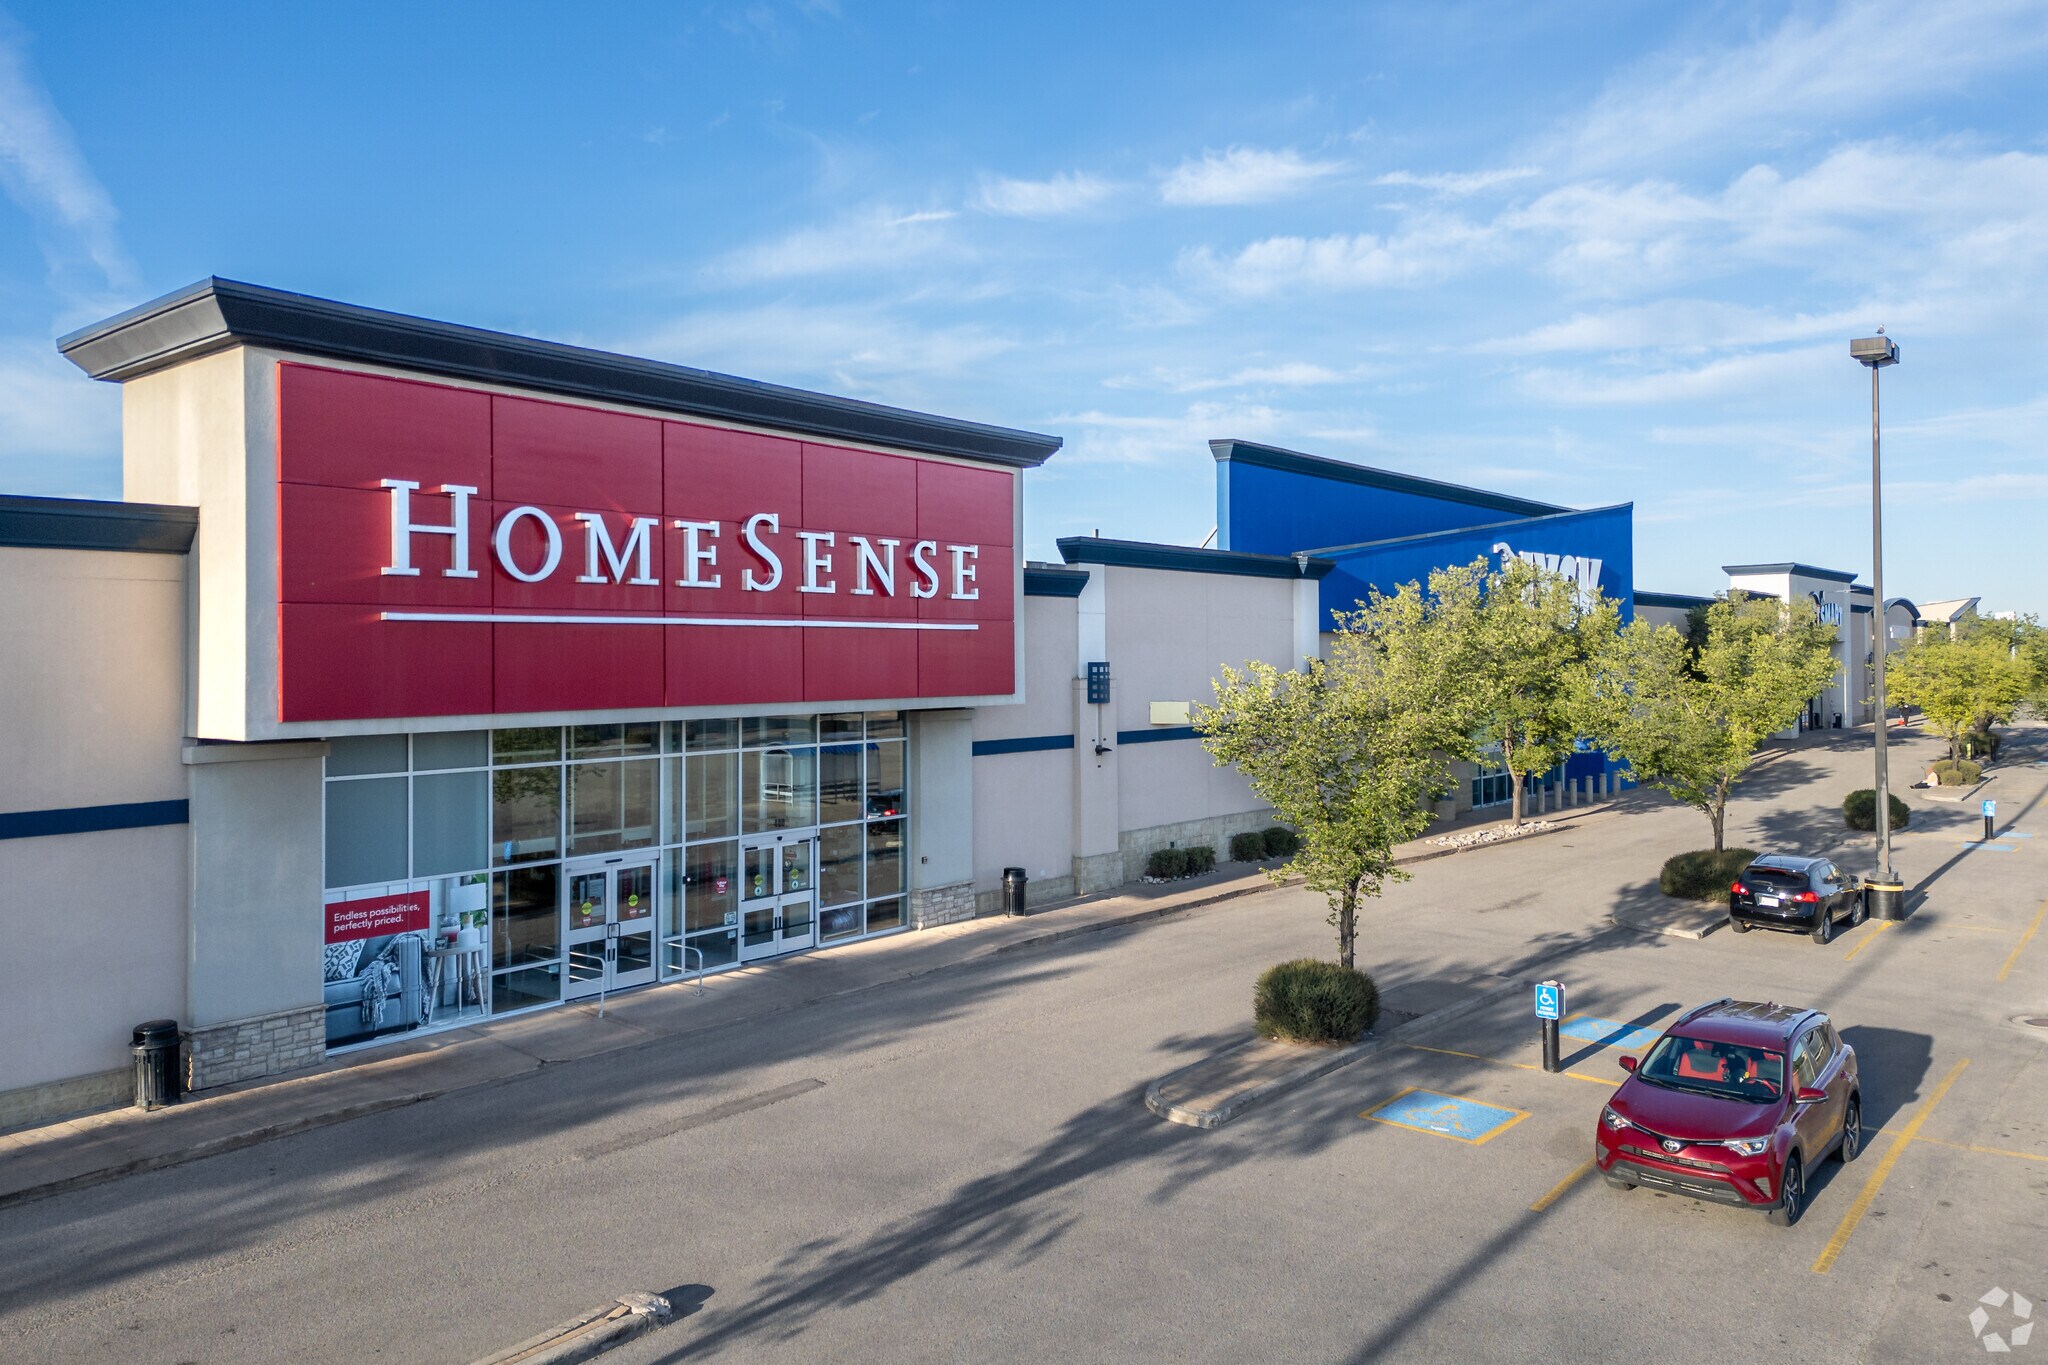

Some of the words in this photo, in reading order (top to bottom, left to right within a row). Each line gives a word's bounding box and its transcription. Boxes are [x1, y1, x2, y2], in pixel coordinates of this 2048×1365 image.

[380, 478, 979, 600] HOMESENSE
[334, 911, 367, 922] Endless
[370, 904, 420, 918] possibilities,
[334, 919, 372, 933] perfectly
[375, 914, 404, 927] priced.
